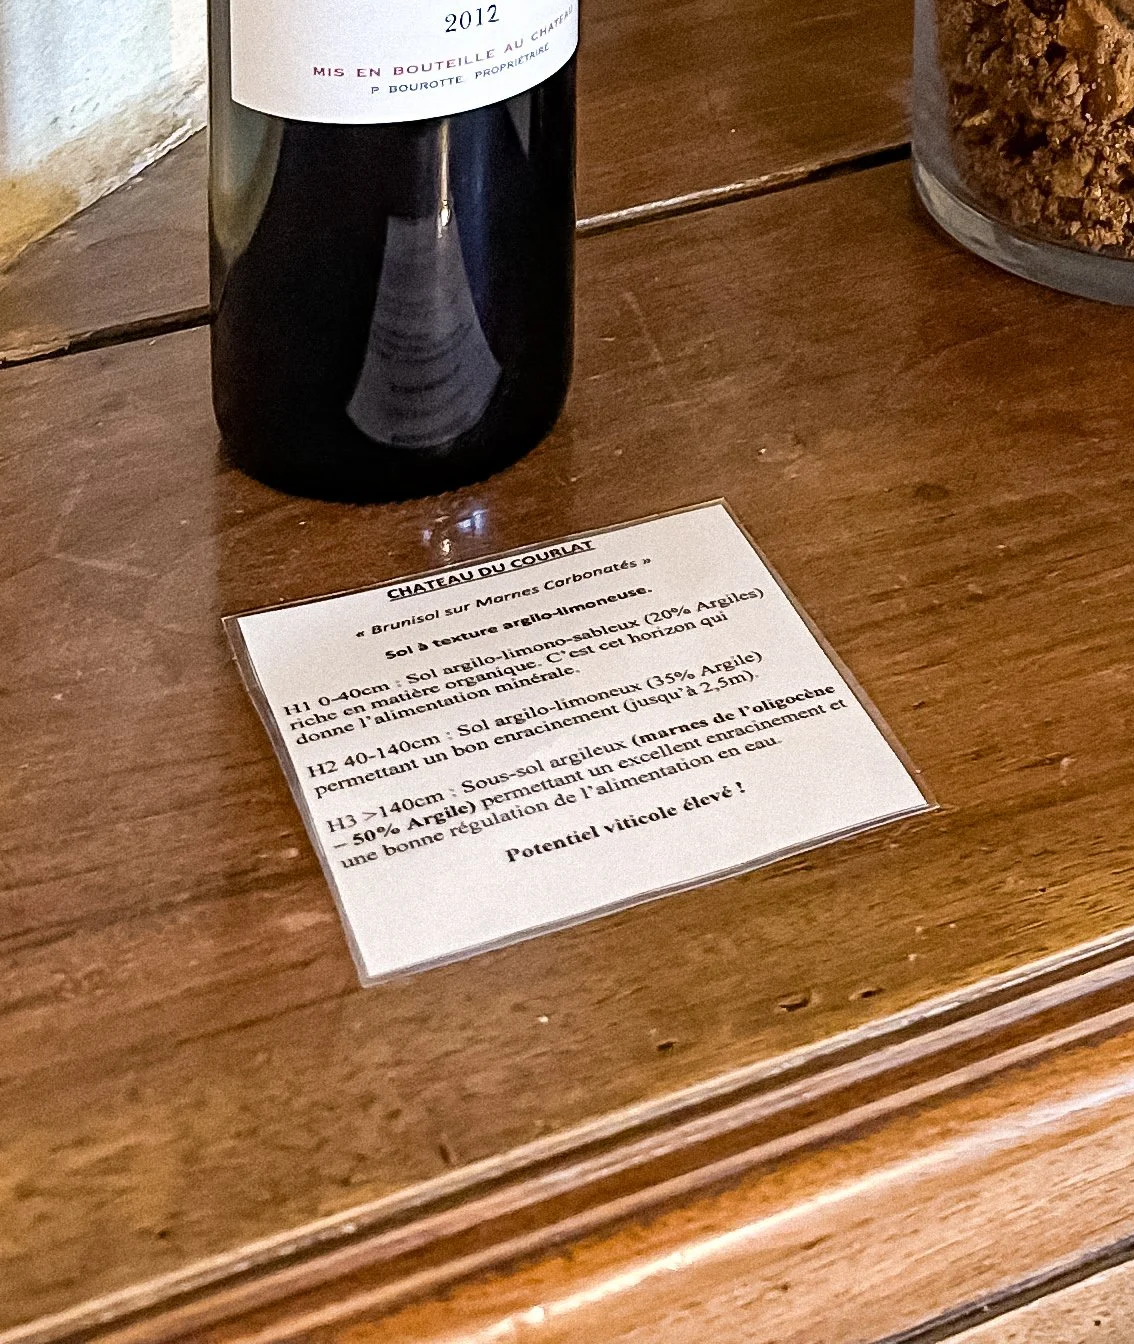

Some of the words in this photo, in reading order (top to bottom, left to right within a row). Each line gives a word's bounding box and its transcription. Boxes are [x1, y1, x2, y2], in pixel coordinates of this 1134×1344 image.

[313, 66, 345, 77] MIS
[356, 67, 381, 78] EN
[393, 48, 496, 76] BOUTEILLE
[504, 38, 524, 54] AU
[531, 4, 573, 41] CHATEAU
[445, 4, 500, 33] 2012
[389, 75, 464, 94] BOUROTTE
[372, 610, 439, 635] Brunisol
[445, 603, 470, 616] sur
[476, 587, 540, 608] Marnes
[544, 560, 637, 590] Carbonatés
[387, 571, 474, 600] CHATEAU
[478, 563, 508, 578] DU
[510, 540, 596, 570] COURLAT
[283, 701, 310, 716] H1
[318, 684, 390, 706] 0-40cm
[406, 669, 438, 684] Sol
[443, 620, 640, 675] argilo-limono-sableux
[644, 606, 691, 625] (20%
[697, 588, 764, 612] Argiles)
[385, 646, 413, 659] Sol
[418, 643, 429, 651] à
[432, 627, 498, 647] texture
[502, 588, 652, 630] argilo-limoneuse.
[290, 712, 337, 731] riche
[343, 705, 366, 716] en
[371, 686, 440, 709] matière
[445, 661, 542, 689] organique.
[599, 638, 626, 650] cet
[627, 622, 697, 644] horizon
[700, 611, 728, 627] qui
[296, 724, 354, 745] donne
[495, 667, 580, 693] minérale.
[307, 761, 338, 778] H2
[344, 736, 441, 767] 40-140cm
[457, 719, 490, 736] Sol
[494, 683, 642, 727] argilo-limoneux
[646, 670, 696, 689] (35%
[701, 651, 762, 677] Argile)
[314, 759, 419, 799] permettant
[423, 752, 448, 765] un
[450, 741, 489, 756] bon
[494, 705, 620, 745] enracinement
[699, 670, 758, 693] 2,5m).
[326, 814, 357, 833] H3
[363, 793, 445, 820] >140cm
[461, 760, 545, 793] Sous-sol
[550, 741, 628, 768] argileux
[632, 720, 709, 747] (marnes
[713, 713, 735, 724] de
[340, 851, 378, 868] une
[382, 823, 444, 856] bonne
[444, 802, 549, 837] régulation
[554, 793, 576, 807] de
[718, 748, 741, 759] en
[744, 737, 782, 752] eau.
[353, 823, 400, 846] 50%
[407, 801, 476, 830] Argile)
[480, 771, 584, 810] permettant
[587, 764, 614, 777] un
[618, 738, 702, 769] excellent
[706, 705, 827, 744] enracinement
[830, 699, 848, 710] et
[505, 826, 600, 862] Potentiel
[603, 807, 677, 833] viticole
[683, 786, 732, 811] élevé
